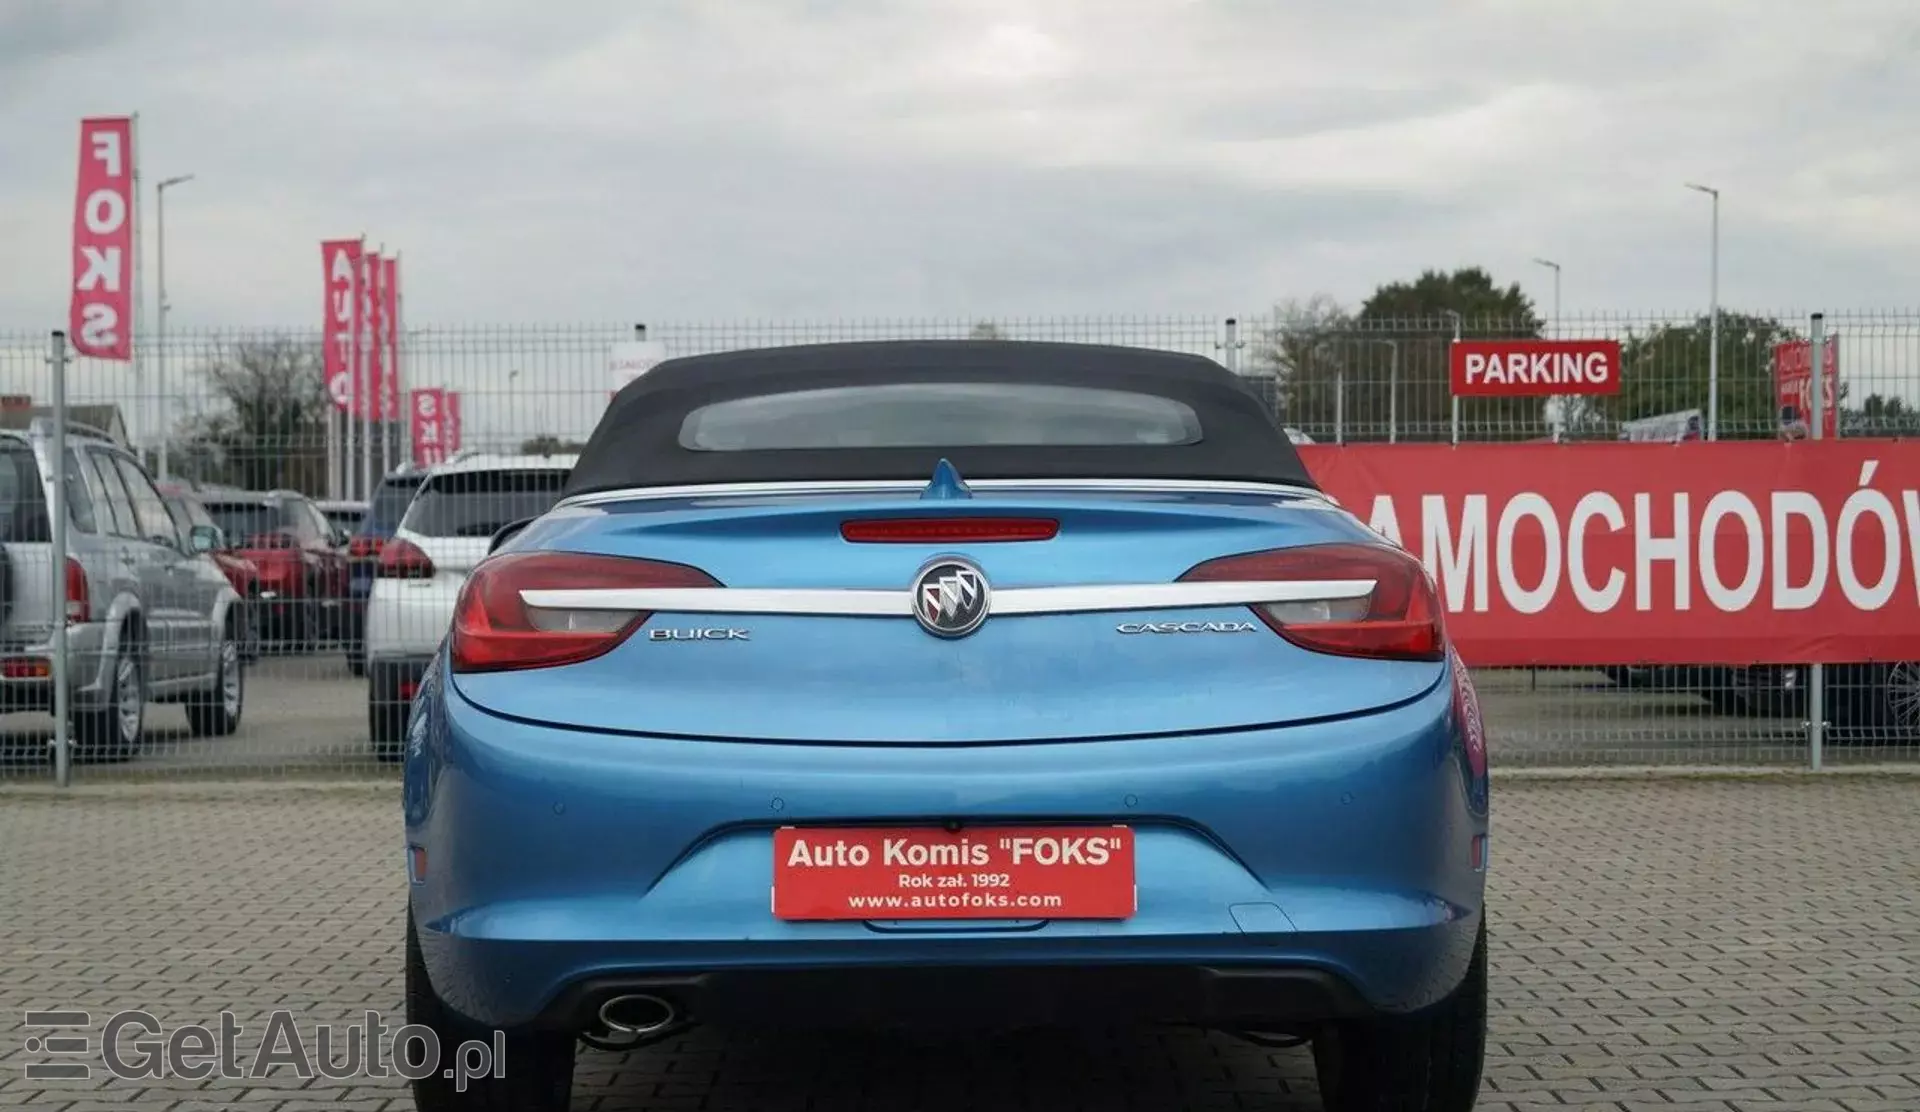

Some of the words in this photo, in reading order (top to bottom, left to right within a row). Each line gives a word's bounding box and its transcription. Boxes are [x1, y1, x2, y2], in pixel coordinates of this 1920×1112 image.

[1465, 352, 1608, 384] PARKING
[649, 628, 751, 641] BUICK
[1116, 622, 1257, 633] CASCADA
[787, 839, 870, 867] Auto
[883, 838, 989, 866] Komis
[999, 837, 1121, 866] "FOKS"
[899, 873, 933, 888] Rok
[937, 872, 967, 888] zał.
[971, 873, 1010, 888] 1992
[848, 892, 1062, 908] www.autofoks.com
